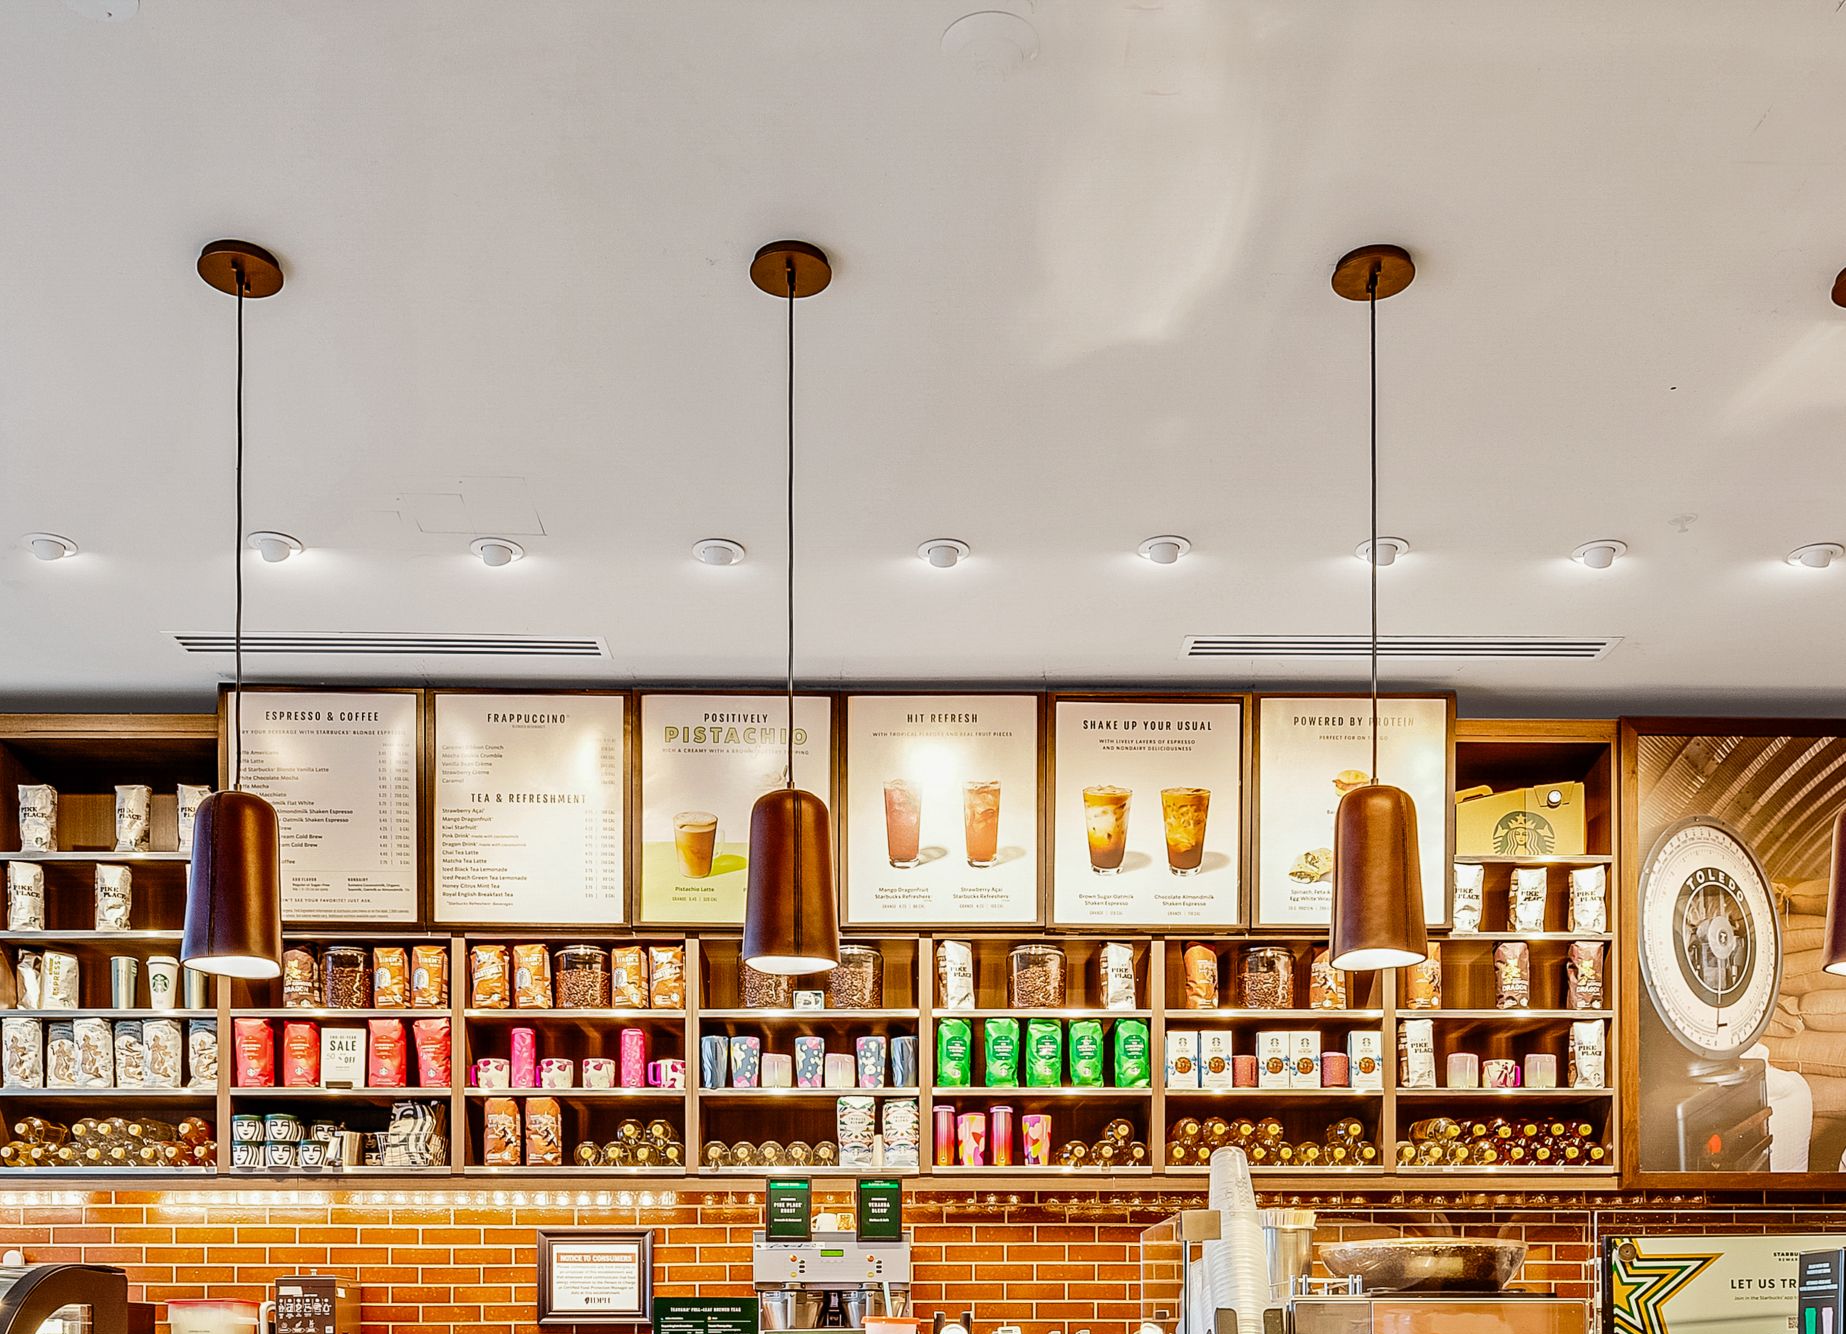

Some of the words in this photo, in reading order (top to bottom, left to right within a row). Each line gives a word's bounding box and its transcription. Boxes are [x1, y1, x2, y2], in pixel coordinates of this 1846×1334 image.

[265, 711, 321, 721] ESPRESSO
[327, 712, 334, 721] &
[340, 712, 379, 721] COFFEE
[487, 713, 566, 724] FRAPPUCCINO
[704, 713, 768, 723] POSITIVELY
[907, 713, 924, 723] HIT
[930, 713, 978, 723] REFRESH
[1083, 720, 1118, 730] SHAKE
[1123, 720, 1137, 730] UP
[1143, 720, 1171, 731] YOUR
[1177, 721, 1212, 731] USUAL
[1294, 717, 1344, 727] POWERED
[1349, 717, 1363, 727] BY
[664, 726, 808, 746] PISTACHIO
[471, 793, 490, 803] TEA
[496, 793, 502, 803] &
[509, 793, 586, 804] REFRESHMENT
[1685, 868, 1745, 902] TOLEDO
[329, 1041, 357, 1052] SALE
[344, 1056, 356, 1064] OFF
[560, 1254, 581, 1263] NOTICE
[582, 1254, 591, 1263] TO
[592, 1254, 633, 1263] CONSUMERS
[1731, 1279, 1753, 1289] LET
[1758, 1279, 1775, 1289] US
[1780, 1278, 1797, 1288] TR
